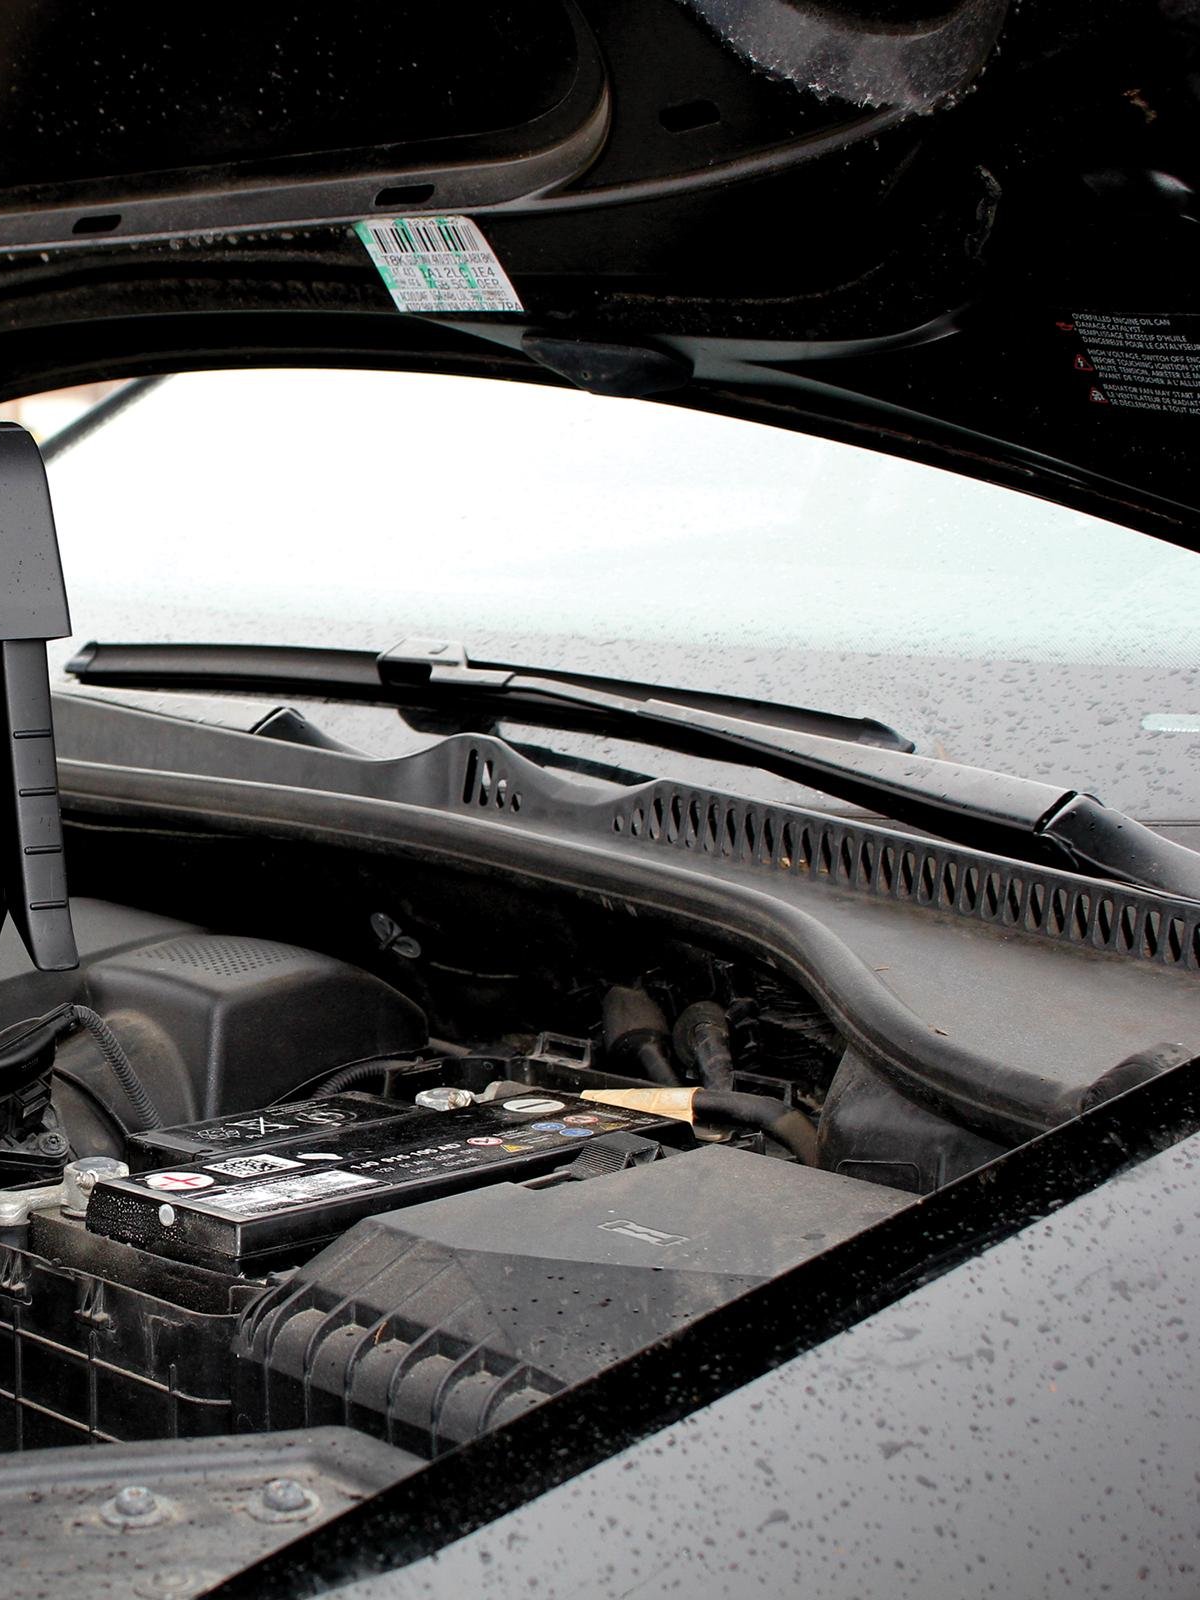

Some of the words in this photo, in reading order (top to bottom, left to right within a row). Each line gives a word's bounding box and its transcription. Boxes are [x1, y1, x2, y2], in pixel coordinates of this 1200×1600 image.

[471, 266, 495, 278] 1E4
[1071, 313, 1111, 323] OVERFILLED
[1111, 316, 1140, 326] ENGINE
[1140, 318, 1153, 326] OIL
[1153, 318, 1170, 326] CAN
[1075, 321, 1107, 330] DAMAGE
